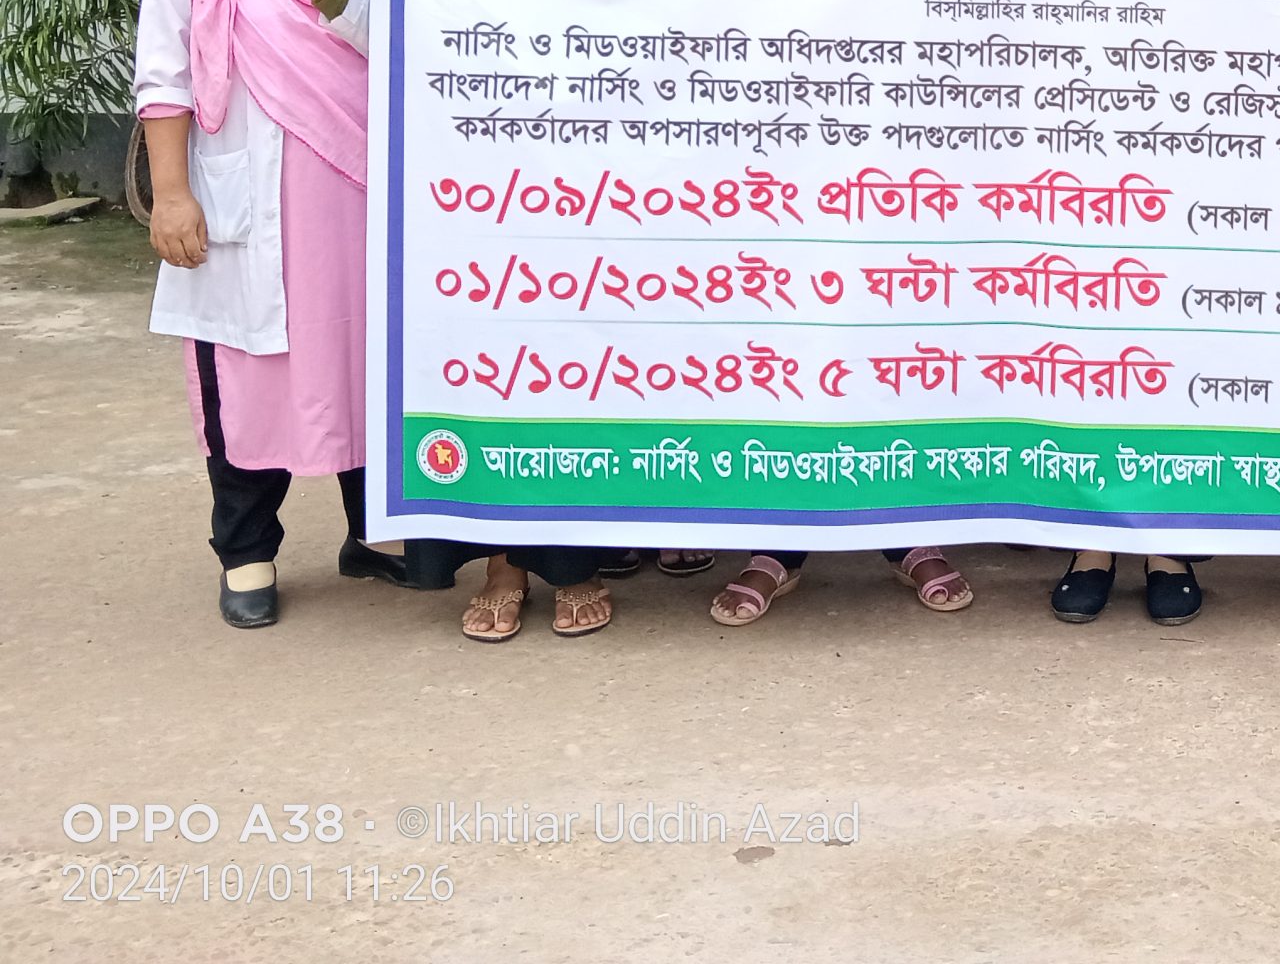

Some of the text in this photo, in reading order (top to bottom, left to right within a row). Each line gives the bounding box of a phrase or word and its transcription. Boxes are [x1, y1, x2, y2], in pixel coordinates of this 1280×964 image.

[1117, 2, 1165, 25] রাহিম
[442, 22, 517, 58] নার্সিং
[530, 35, 551, 55] ও
[563, 25, 751, 63] মিডওয়াইফারি
[759, 29, 906, 64] অধিদপ্তরের
[914, 34, 1091, 76] মহাপরিচালক,
[1104, 39, 1217, 72] অতিরিক্ত
[427, 70, 558, 100] বাংলাদেশ
[567, 68, 643, 104] নার্সিং
[654, 80, 675, 100] ও
[687, 70, 874, 107] মিডওয়াইফারি
[882, 75, 1024, 108] কাউন্সিলের
[1035, 79, 1159, 112] প্রেসিডেন্ট
[1170, 92, 1189, 112] ও
[452, 108, 612, 144] কর্মকর্তাদের
[620, 113, 810, 156] অপসারণপূর্বক
[818, 115, 871, 146] উক্ত
[882, 123, 1027, 150] পদগুলোতে
[1035, 120, 1106, 156] নার্সিং
[1114, 122, 1265, 158] কর্মকর্তাদের
[430, 166, 803, 225] ৩০/০৯/২০২৪ইং
[818, 168, 963, 222] প্রতিকি
[973, 169, 1173, 226] কর্মবিরতি
[1188, 202, 1272, 234] (সকাল
[436, 252, 796, 311] ০১/১০/২০২৪ইং
[811, 271, 843, 304] ৩
[969, 253, 1167, 311] কর্মবিরতি
[1182, 285, 1266, 318] (সকাল
[443, 341, 803, 400] ০২/১০/২০২৪ইং
[820, 359, 852, 397] ৫
[976, 342, 1174, 400] কর্মবিরতি
[1189, 373, 1272, 407] (সকাল
[481, 444, 619, 477] আয়োজনে:
[630, 438, 701, 481] নার্সিং
[712, 451, 731, 477] ও
[742, 439, 917, 485] মিডওয়াইফারি
[925, 444, 1011, 479] সংস্কার
[1021, 440, 1104, 490] পরিষদ,
[1116, 444, 1225, 486] উপজেলা
